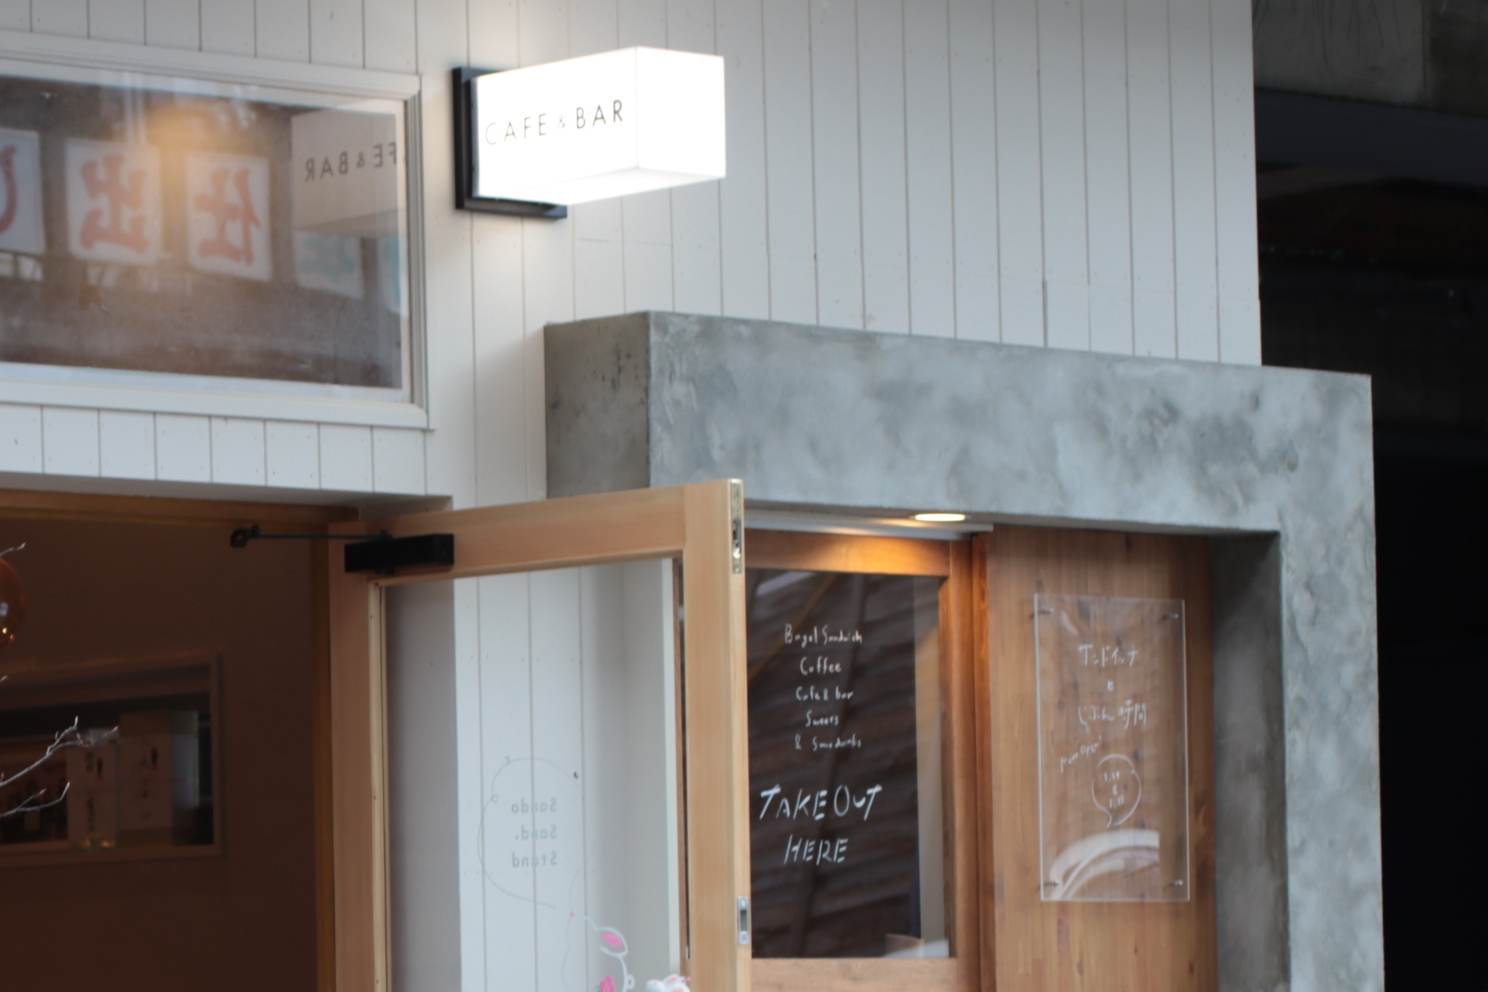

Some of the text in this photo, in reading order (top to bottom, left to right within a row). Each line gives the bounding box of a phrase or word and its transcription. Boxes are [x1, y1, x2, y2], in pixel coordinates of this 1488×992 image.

[485, 113, 547, 145] CAFE
[576, 100, 623, 130] BAR
[800, 655, 842, 675] Coffee
[759, 783, 882, 821] TAKE OUT
[783, 834, 848, 866] HERE
